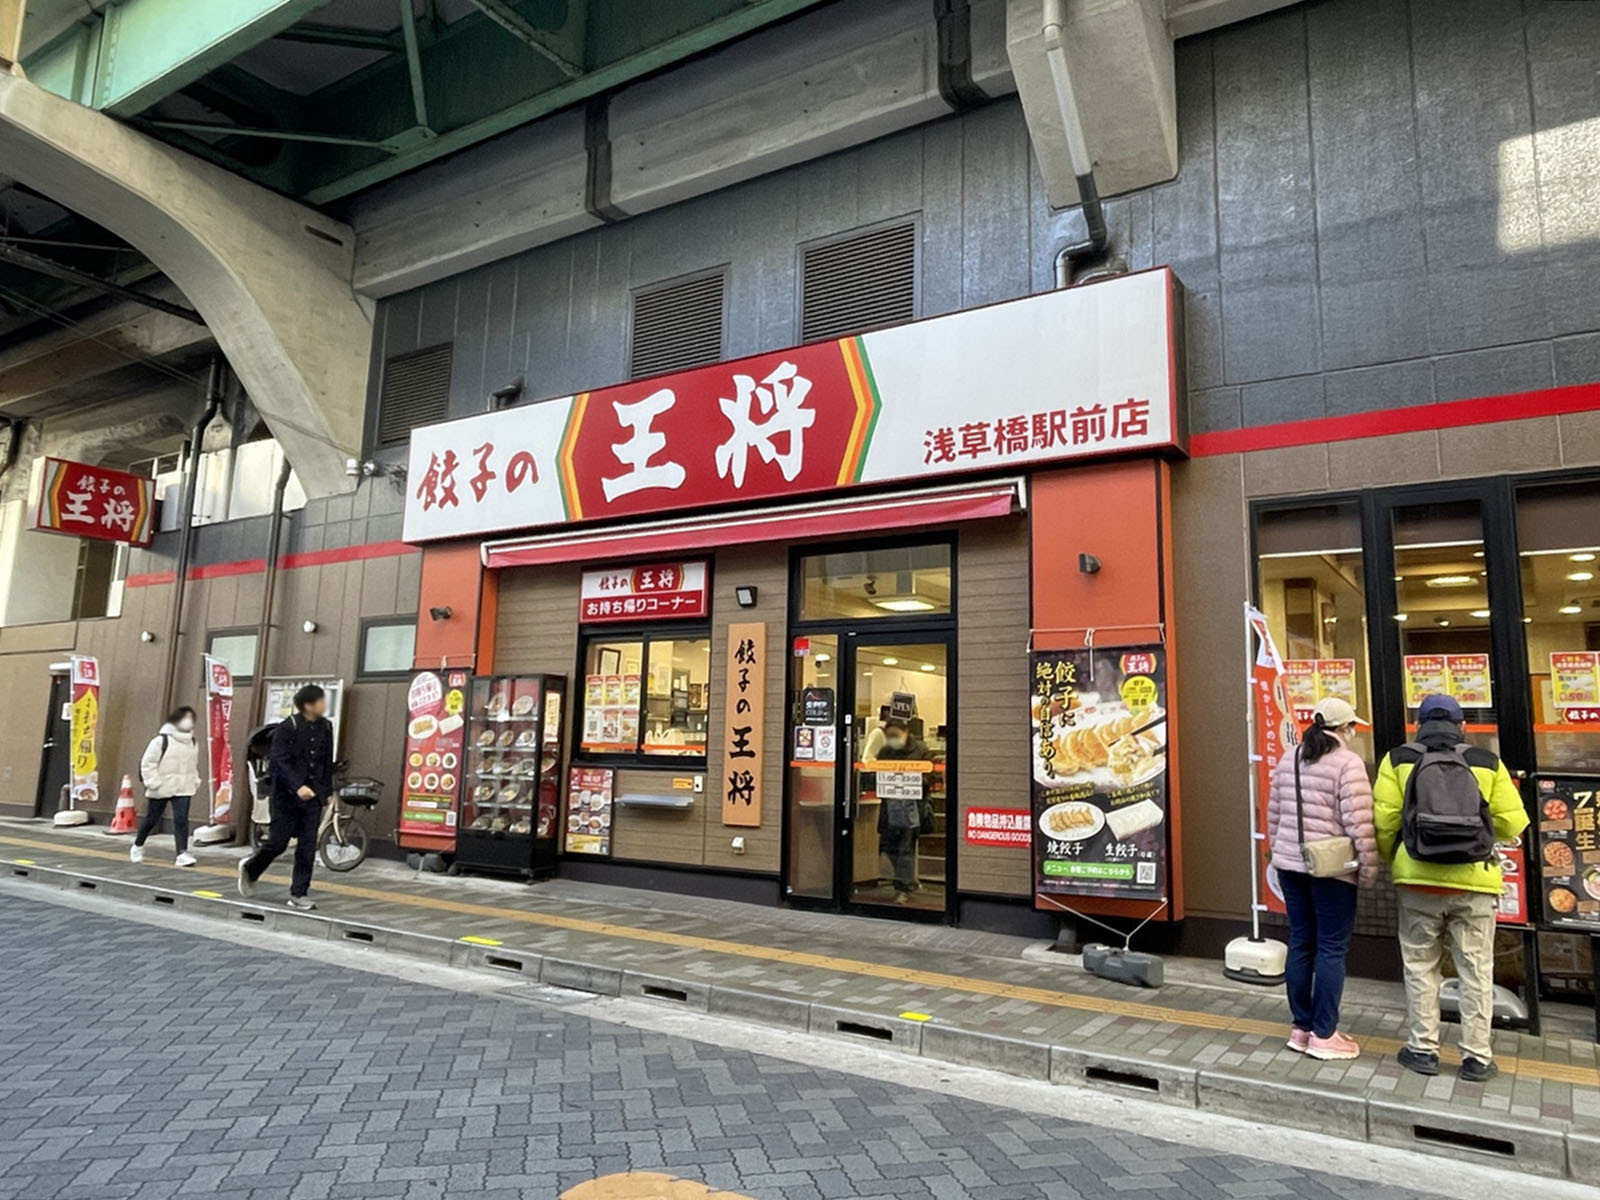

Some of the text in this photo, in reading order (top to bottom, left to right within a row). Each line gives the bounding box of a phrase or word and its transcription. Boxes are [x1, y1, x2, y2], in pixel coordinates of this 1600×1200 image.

[601, 361, 816, 503] 王将
[923, 398, 1150, 464] 浅草橋駅前店
[77, 475, 126, 495] 餃子の
[61, 490, 136, 532] 王将
[640, 569, 676, 590] 王将
[586, 596, 697, 617] お持ち帰りコーナー
[1054, 661, 1078, 728] 餃子に
[728, 639, 757, 806] 餃子の王将
[1047, 841, 1083, 855] 焼餃子
[1105, 843, 1137, 857] 生餃子
